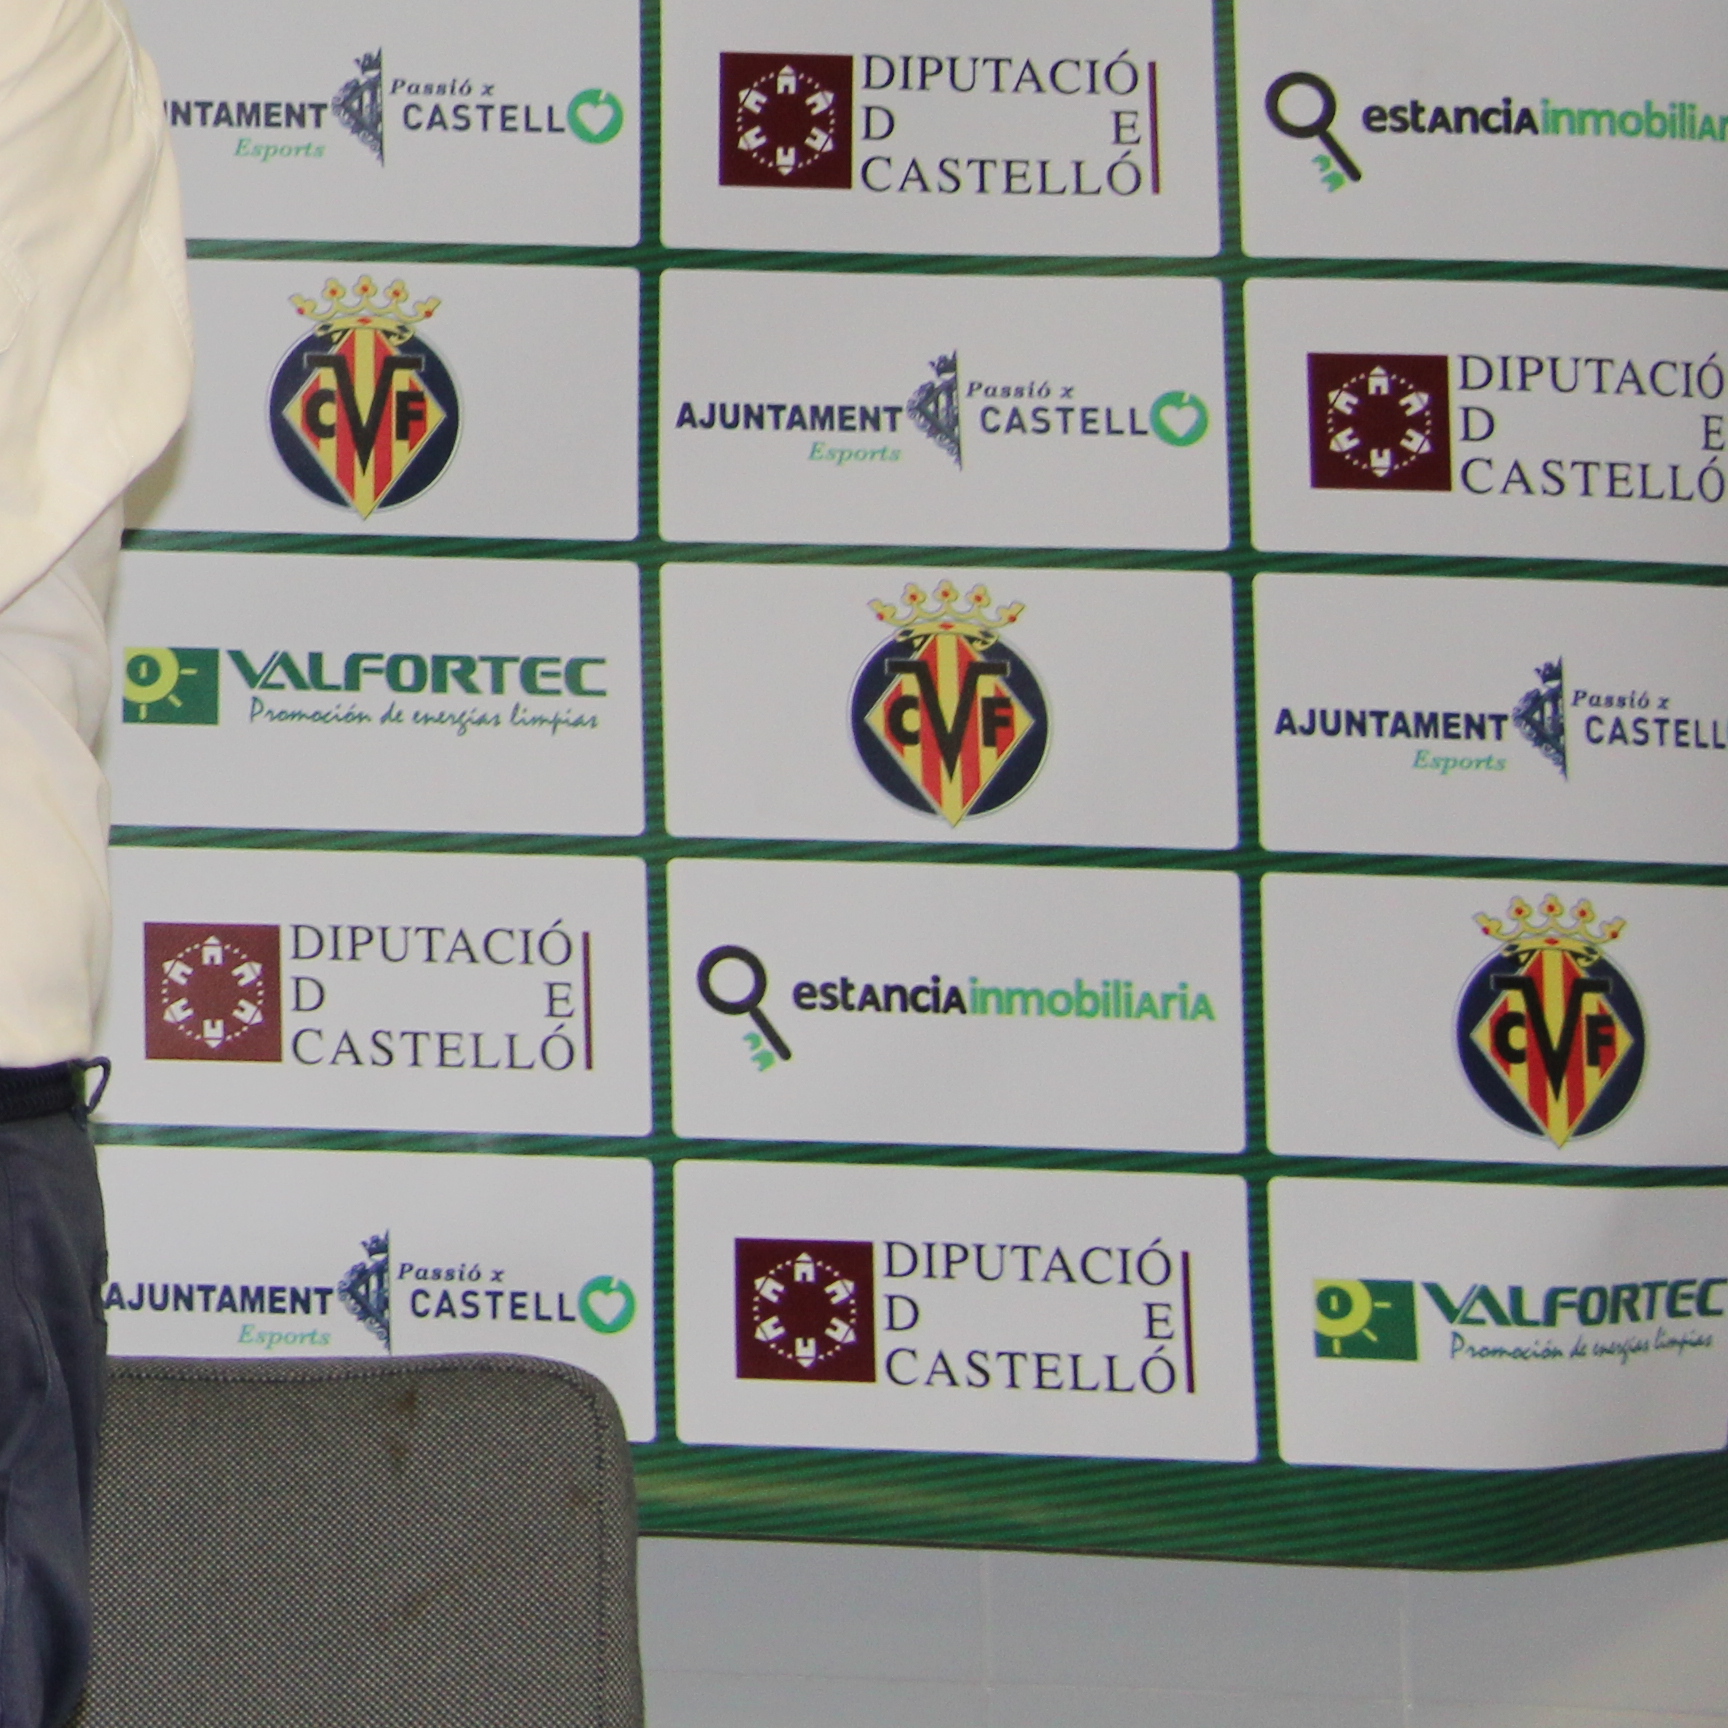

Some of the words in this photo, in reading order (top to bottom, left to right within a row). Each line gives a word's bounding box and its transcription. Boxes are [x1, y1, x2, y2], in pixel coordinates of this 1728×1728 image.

[389, 78, 472, 96] Passió
[863, 49, 1138, 95] DIPUTACIÓ
[235, 138, 325, 162] Esports
[861, 150, 1142, 196] CASTELLÓ
[966, 381, 1051, 399] Passió
[1456, 351, 1725, 400] DIPUTACIÓ
[676, 402, 903, 432] AJUNTAMENT
[808, 441, 901, 465] Esports
[1460, 455, 1726, 504] CASTELLÓ
[226, 649, 607, 697] VALFORTEC
[250, 696, 372, 723] Promoción
[1571, 690, 1650, 709] Passió
[1275, 708, 1509, 741] AJUNTAMENT
[1413, 749, 1507, 775] Esports
[291, 919, 572, 966] DIPUTACIÓ
[292, 1023, 575, 1071] CASTELLÓ
[397, 1262, 482, 1282] Passió
[884, 1237, 1171, 1286] DIPUTACIÓ
[104, 1282, 333, 1314] AJUNTAMENT
[1421, 1278, 1728, 1327] VALFORTEC
[238, 1324, 332, 1350] Esports
[886, 1345, 1176, 1394] CASTELLÓ
